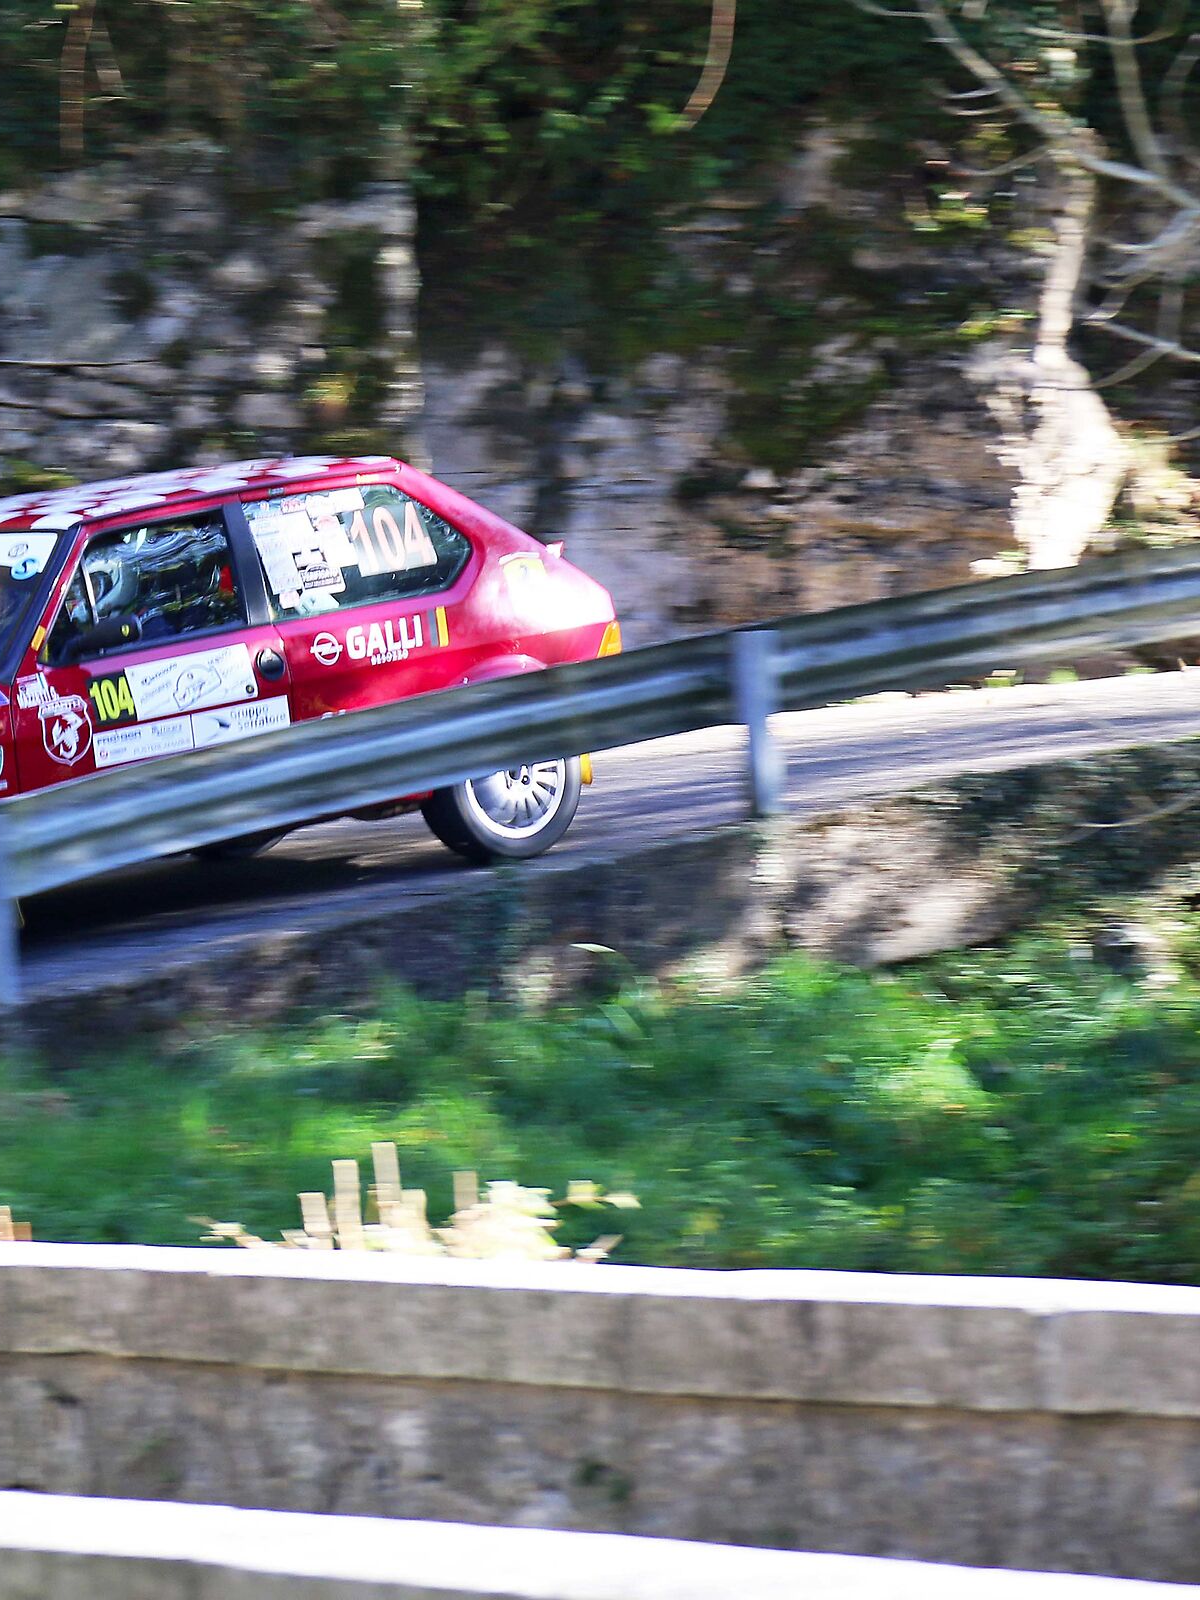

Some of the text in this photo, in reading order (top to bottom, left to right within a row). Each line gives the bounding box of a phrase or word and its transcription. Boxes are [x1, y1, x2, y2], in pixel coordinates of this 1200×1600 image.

[350, 501, 436, 573] 104
[346, 615, 423, 659] GALLI
[89, 676, 135, 722] 104
